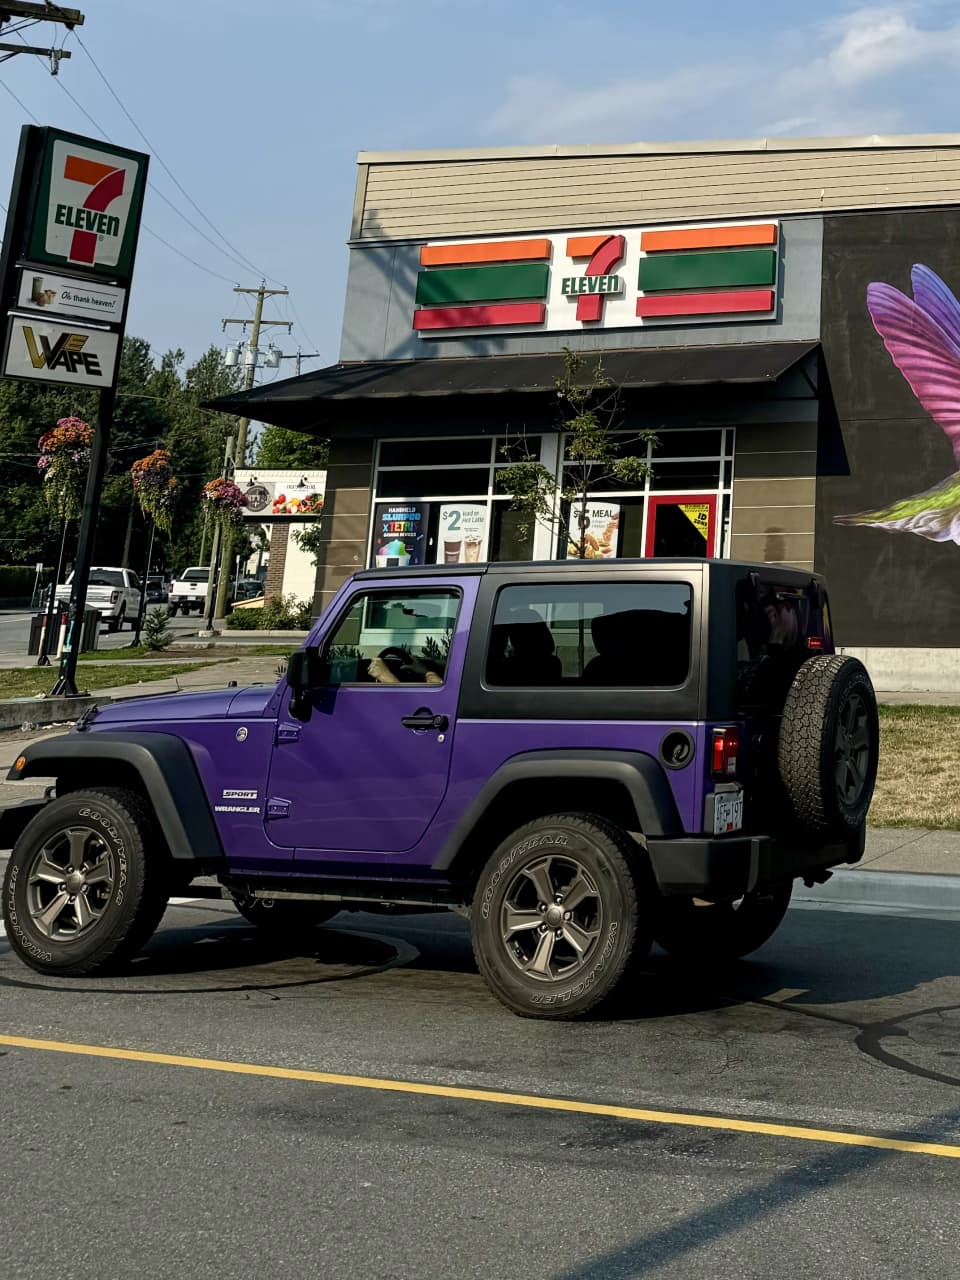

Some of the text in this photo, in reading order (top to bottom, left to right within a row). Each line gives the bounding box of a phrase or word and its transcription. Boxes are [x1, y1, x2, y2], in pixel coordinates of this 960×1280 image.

[64, 154, 126, 265] 7
[61, 291, 116, 308] Oh thank heaven!
[566, 234, 626, 322] 7
[592, 509, 614, 518] MEAL
[698, 512, 707, 521] ID
[214, 805, 260, 813] WRANGLER
[78, 807, 128, 906] GOODYEAR
[481, 835, 568, 919] GOODYEAR
[530, 922, 617, 1004] WRANGLER
